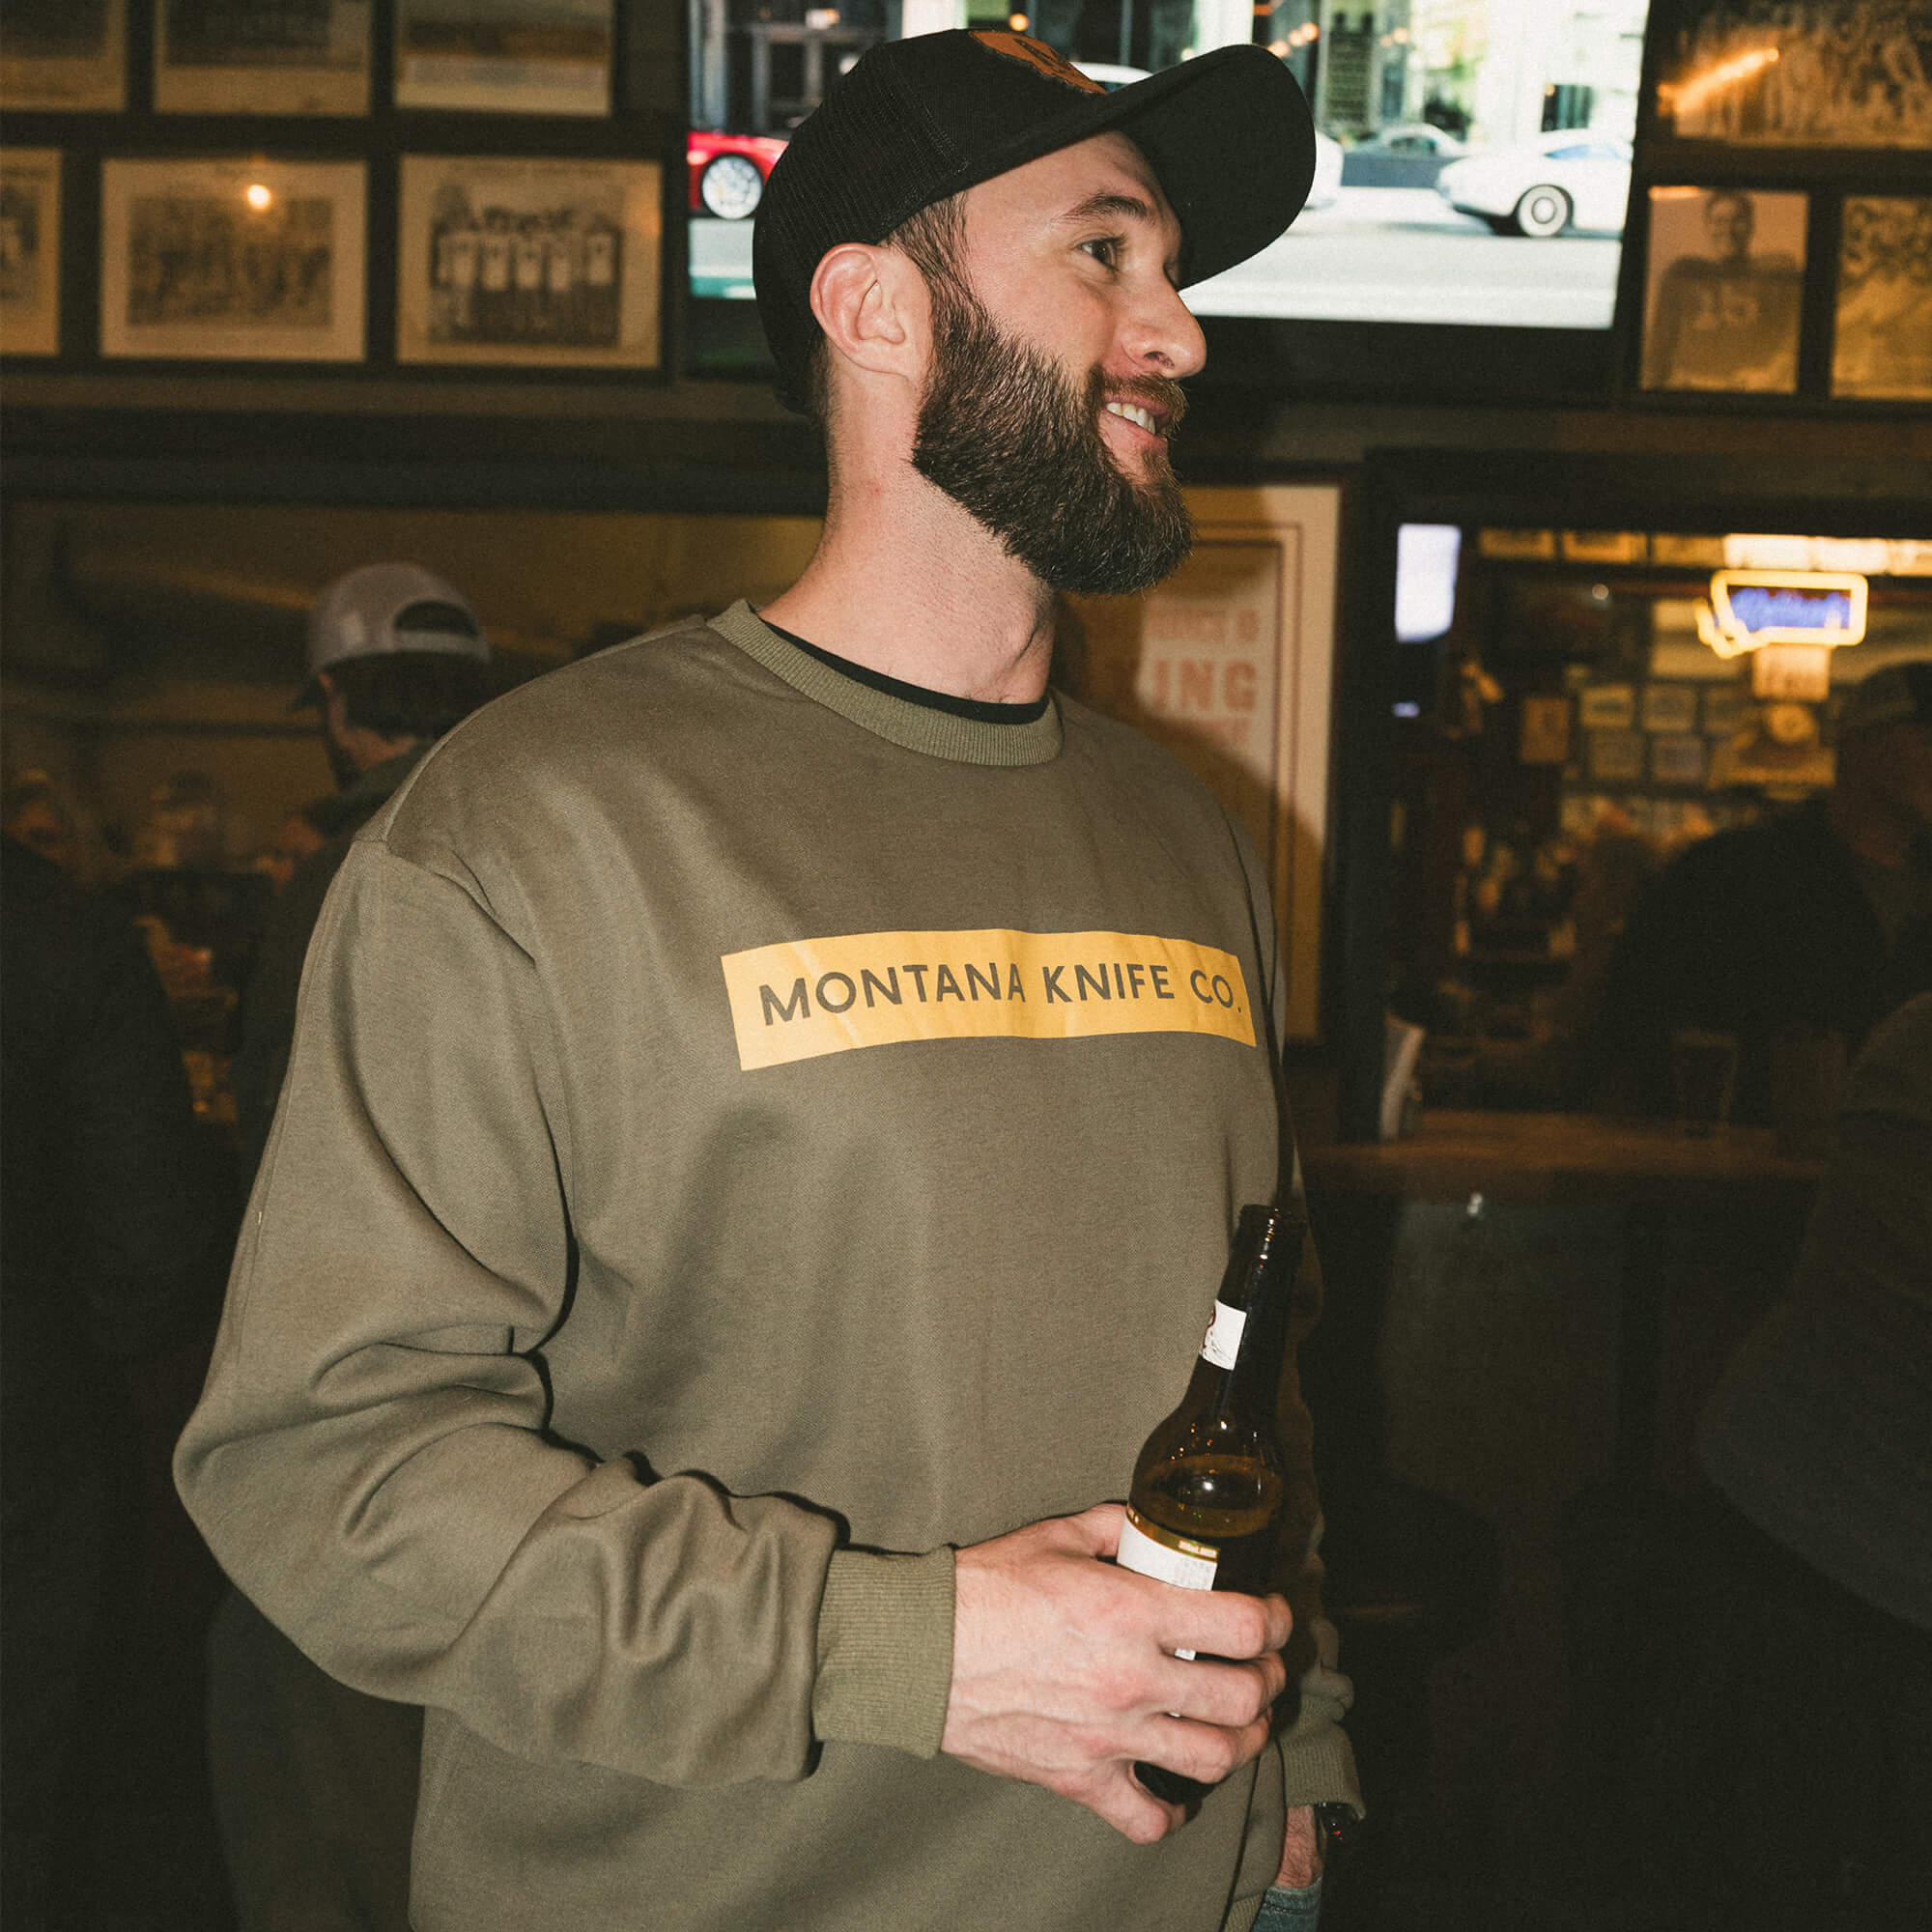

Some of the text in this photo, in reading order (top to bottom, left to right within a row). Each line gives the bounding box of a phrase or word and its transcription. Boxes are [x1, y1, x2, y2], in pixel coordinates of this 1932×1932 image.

[758, 962, 1241, 1026] MONTANA KNIFE CO.
